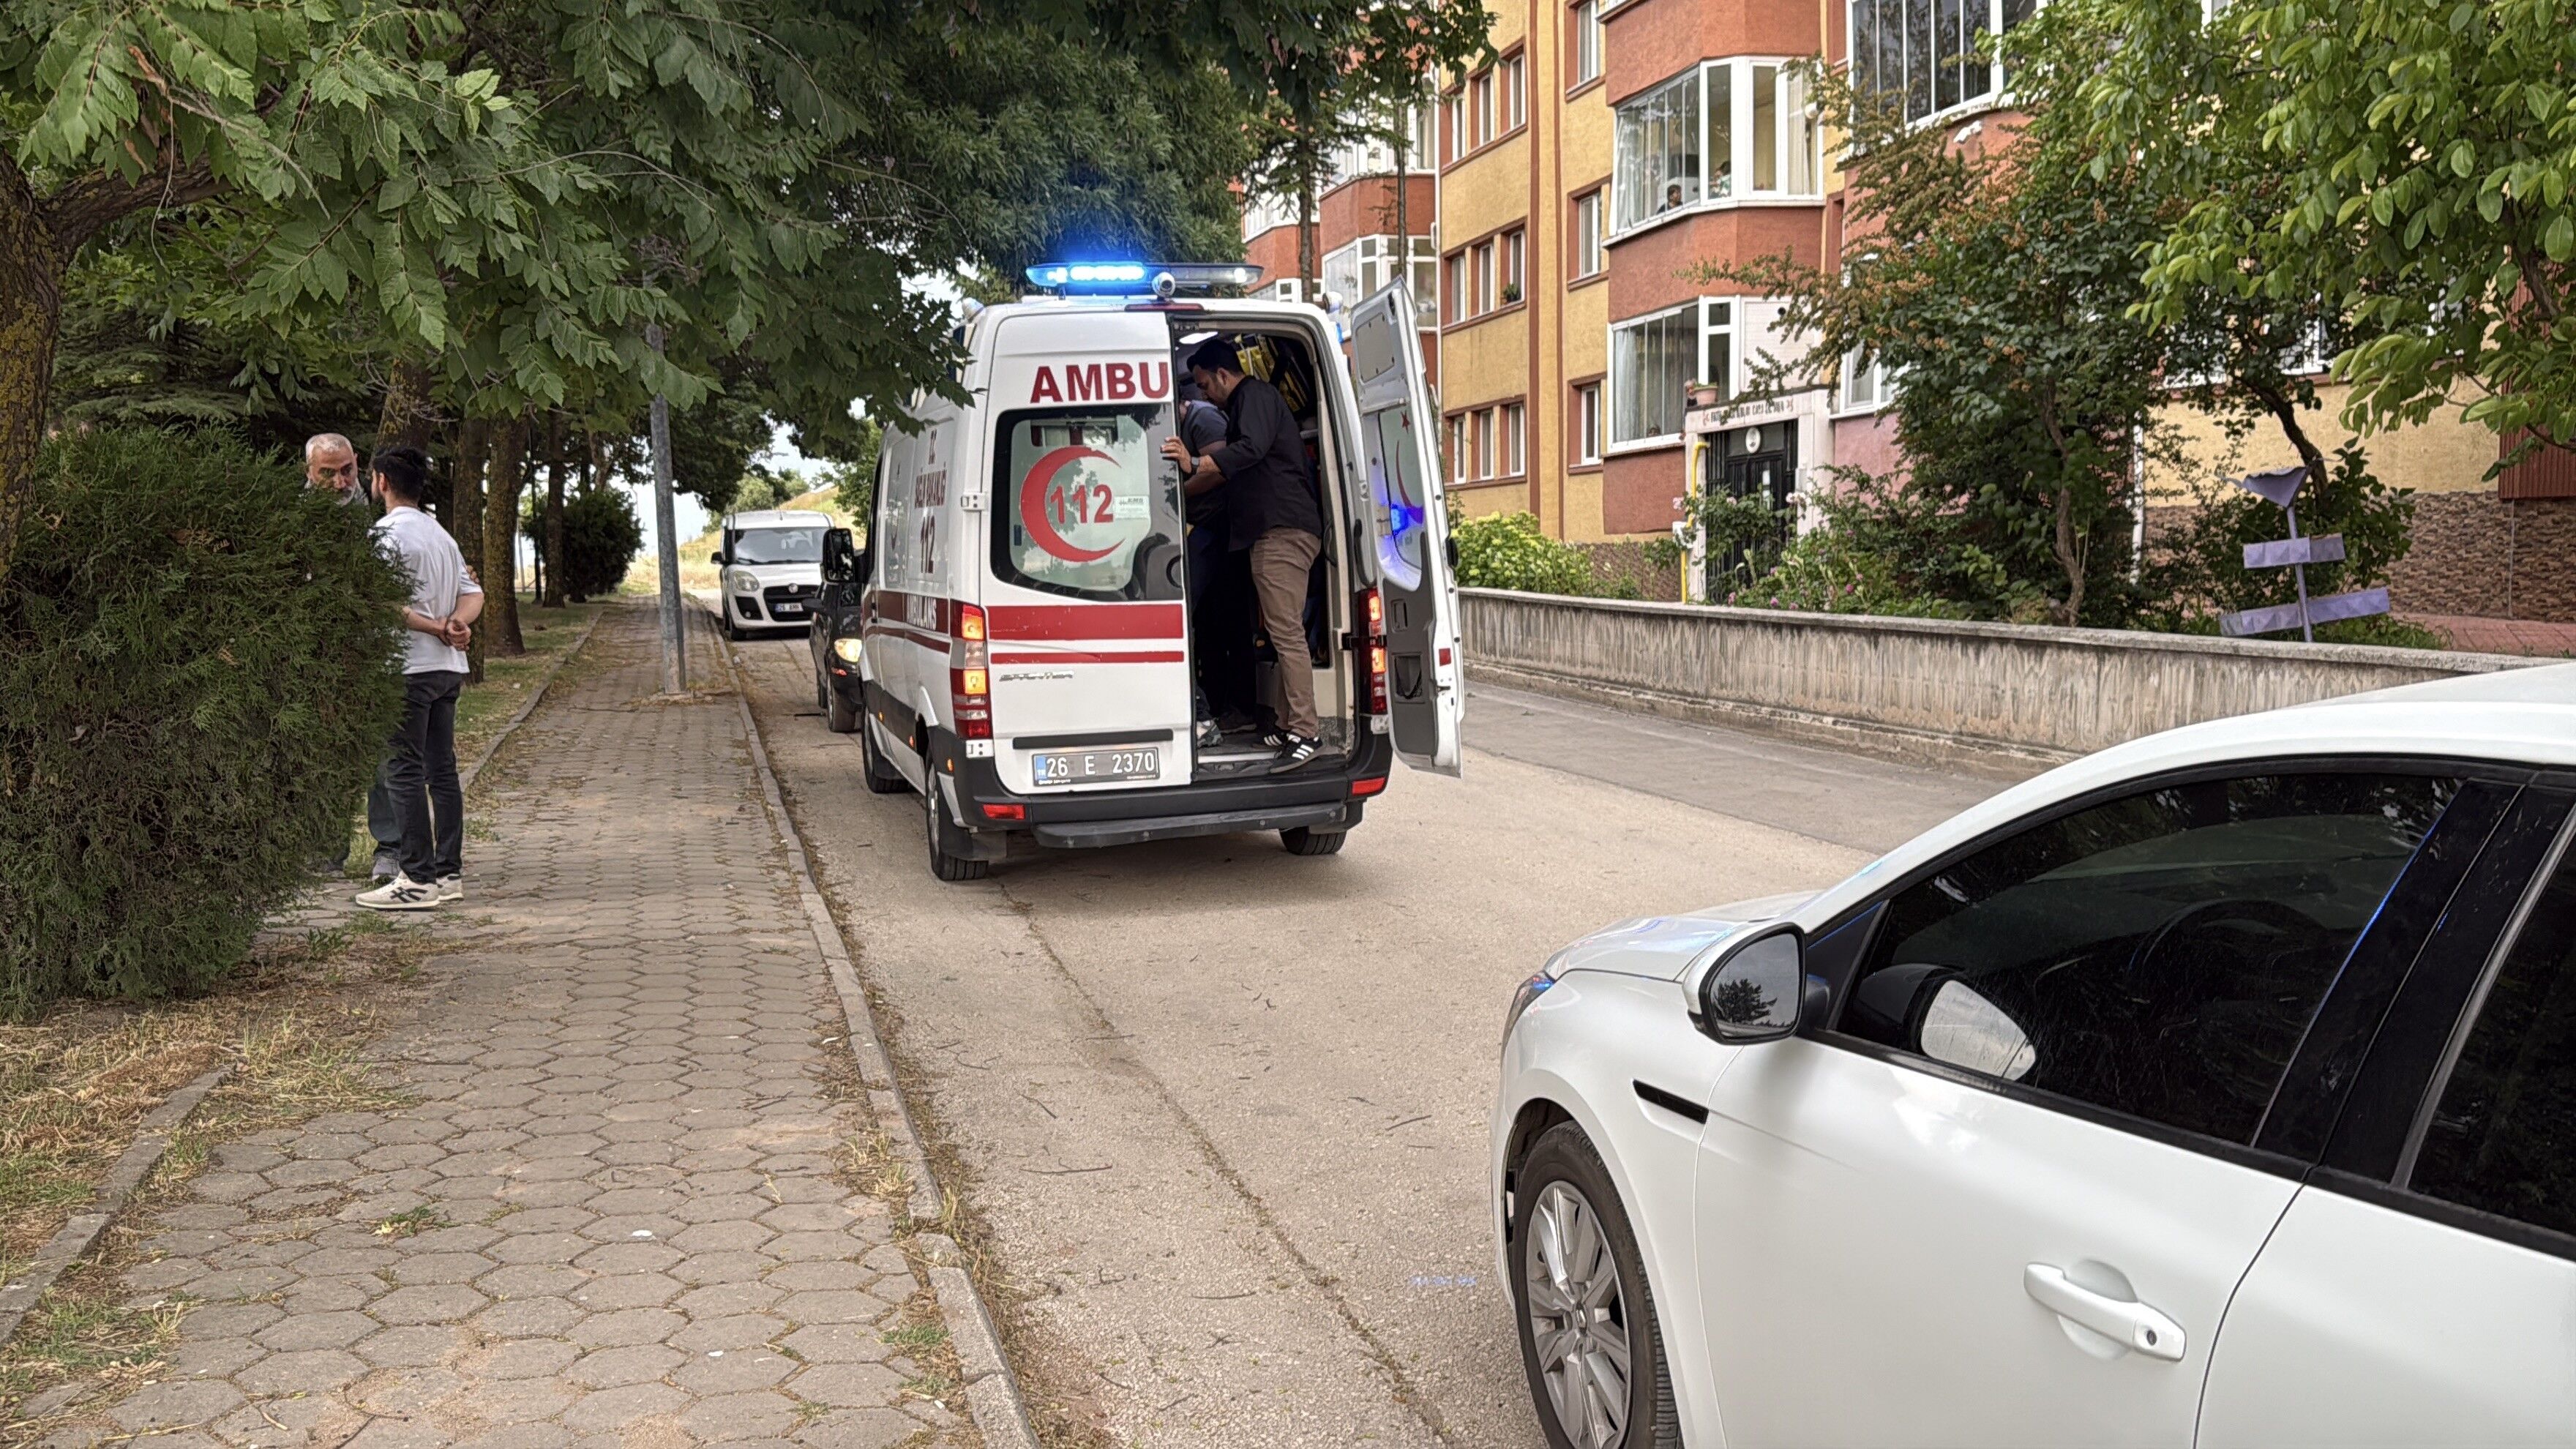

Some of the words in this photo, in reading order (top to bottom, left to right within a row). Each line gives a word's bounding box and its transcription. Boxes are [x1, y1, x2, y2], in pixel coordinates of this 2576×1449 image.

[1030, 362, 1169, 403] AMBU
[1050, 484, 1114, 525] 112
[920, 515, 935, 573] 112
[1046, 757, 1068, 777] 26
[1085, 755, 1096, 775] E
[1112, 752, 1155, 774] 2370
